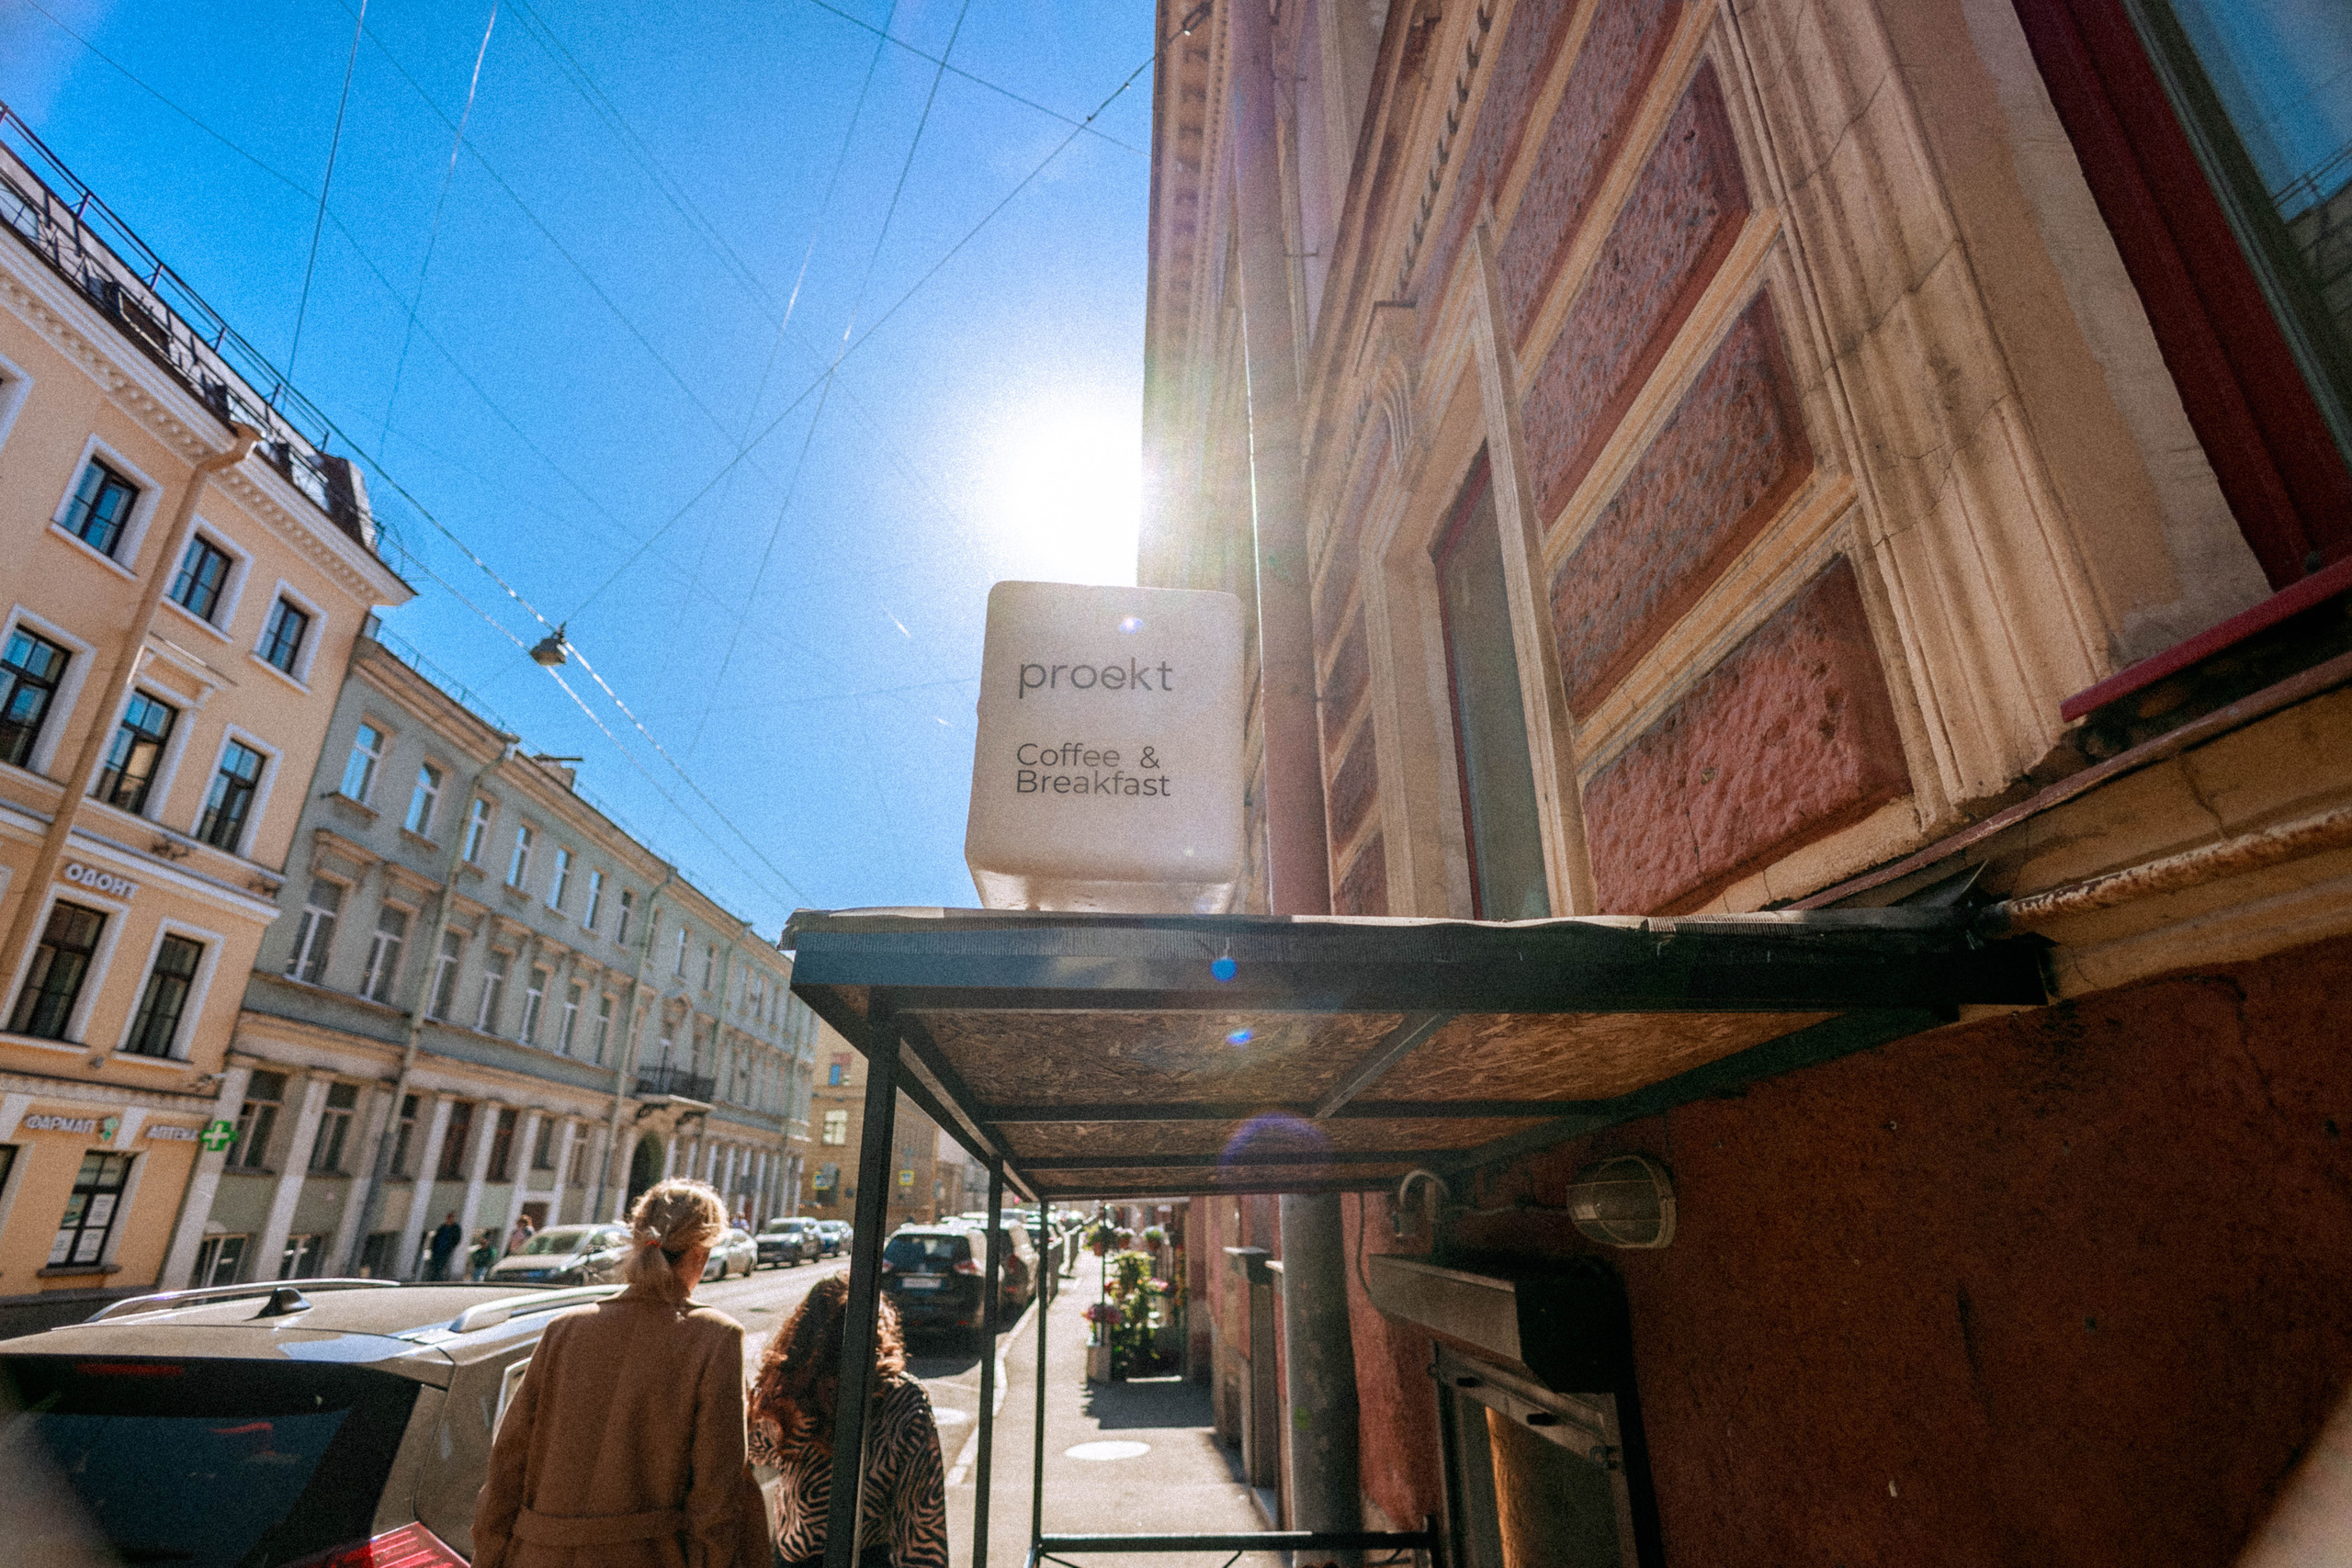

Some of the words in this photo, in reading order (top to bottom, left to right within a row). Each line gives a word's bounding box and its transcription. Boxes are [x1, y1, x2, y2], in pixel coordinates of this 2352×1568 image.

[1018, 656, 1173, 699] proekt
[1016, 742, 1121, 768] Coffee
[1139, 746, 1160, 770] &
[1016, 770, 1171, 797] Breakfast
[65, 863, 140, 899] ОДОНТ
